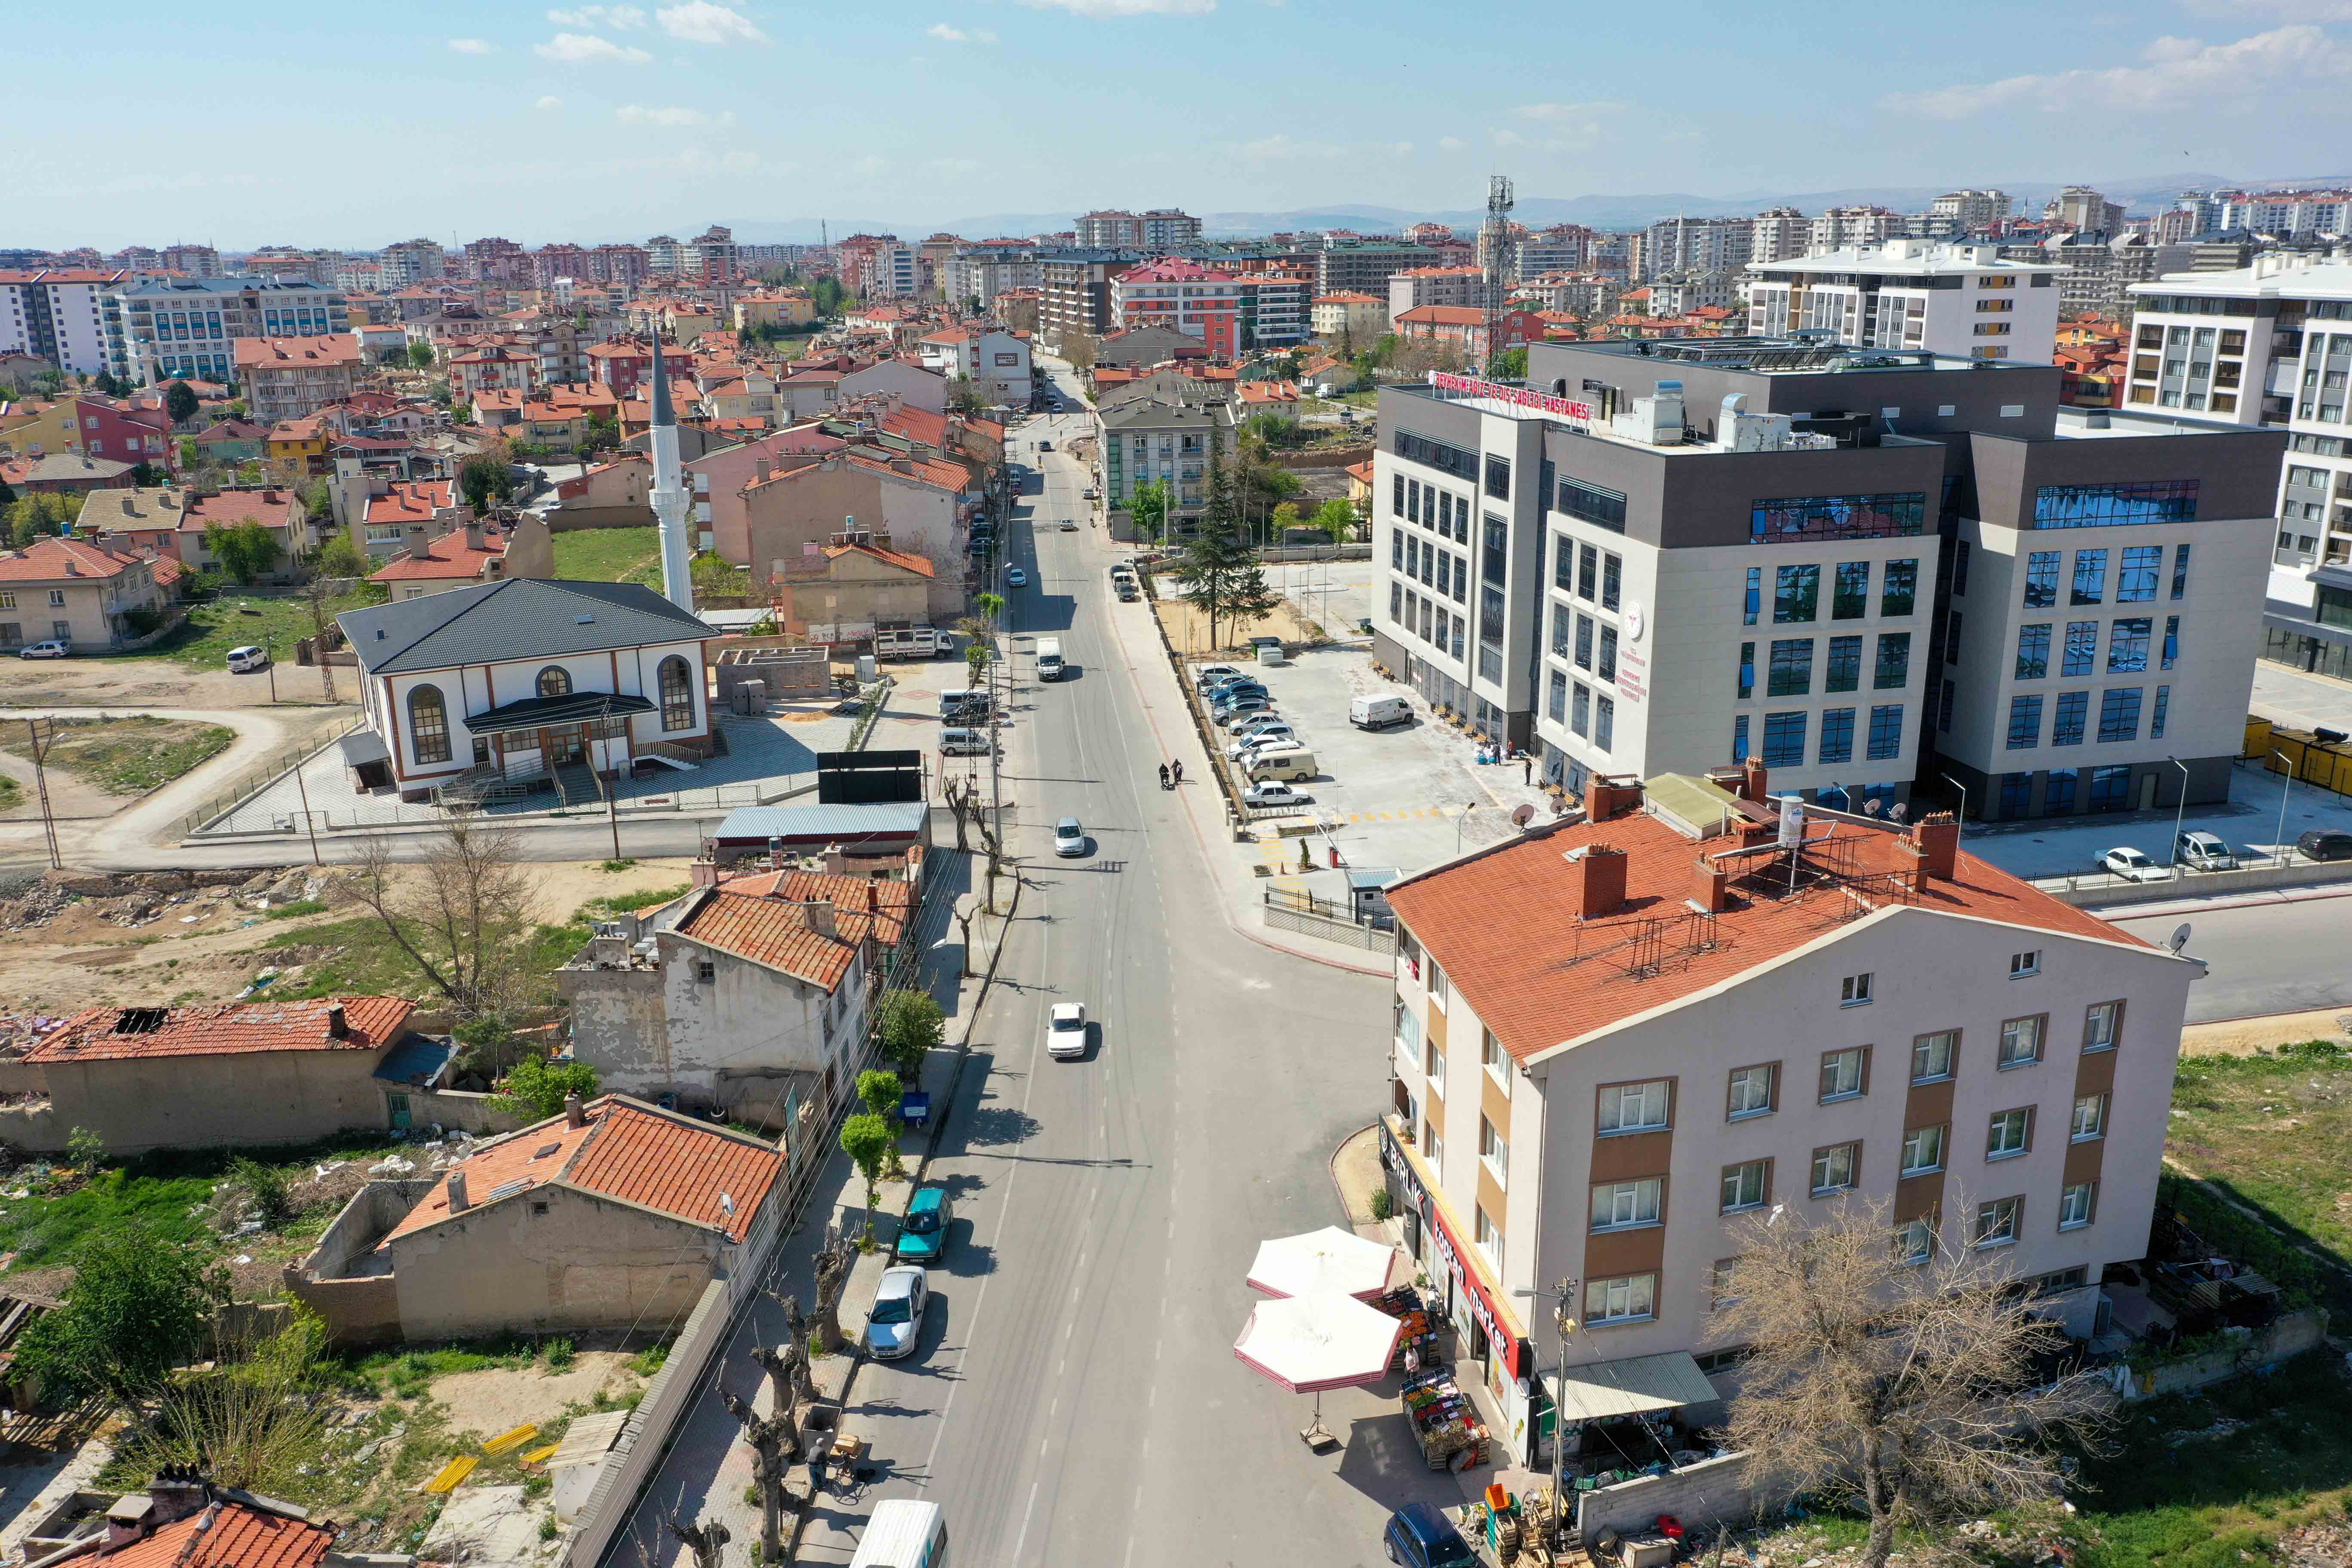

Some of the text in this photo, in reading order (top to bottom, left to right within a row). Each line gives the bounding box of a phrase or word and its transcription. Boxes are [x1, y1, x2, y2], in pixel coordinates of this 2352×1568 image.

[1489, 384, 1497, 398] VE
[1390, 1141, 1424, 1218] BİRLİK
[1435, 1221, 1507, 1360] toptan market
